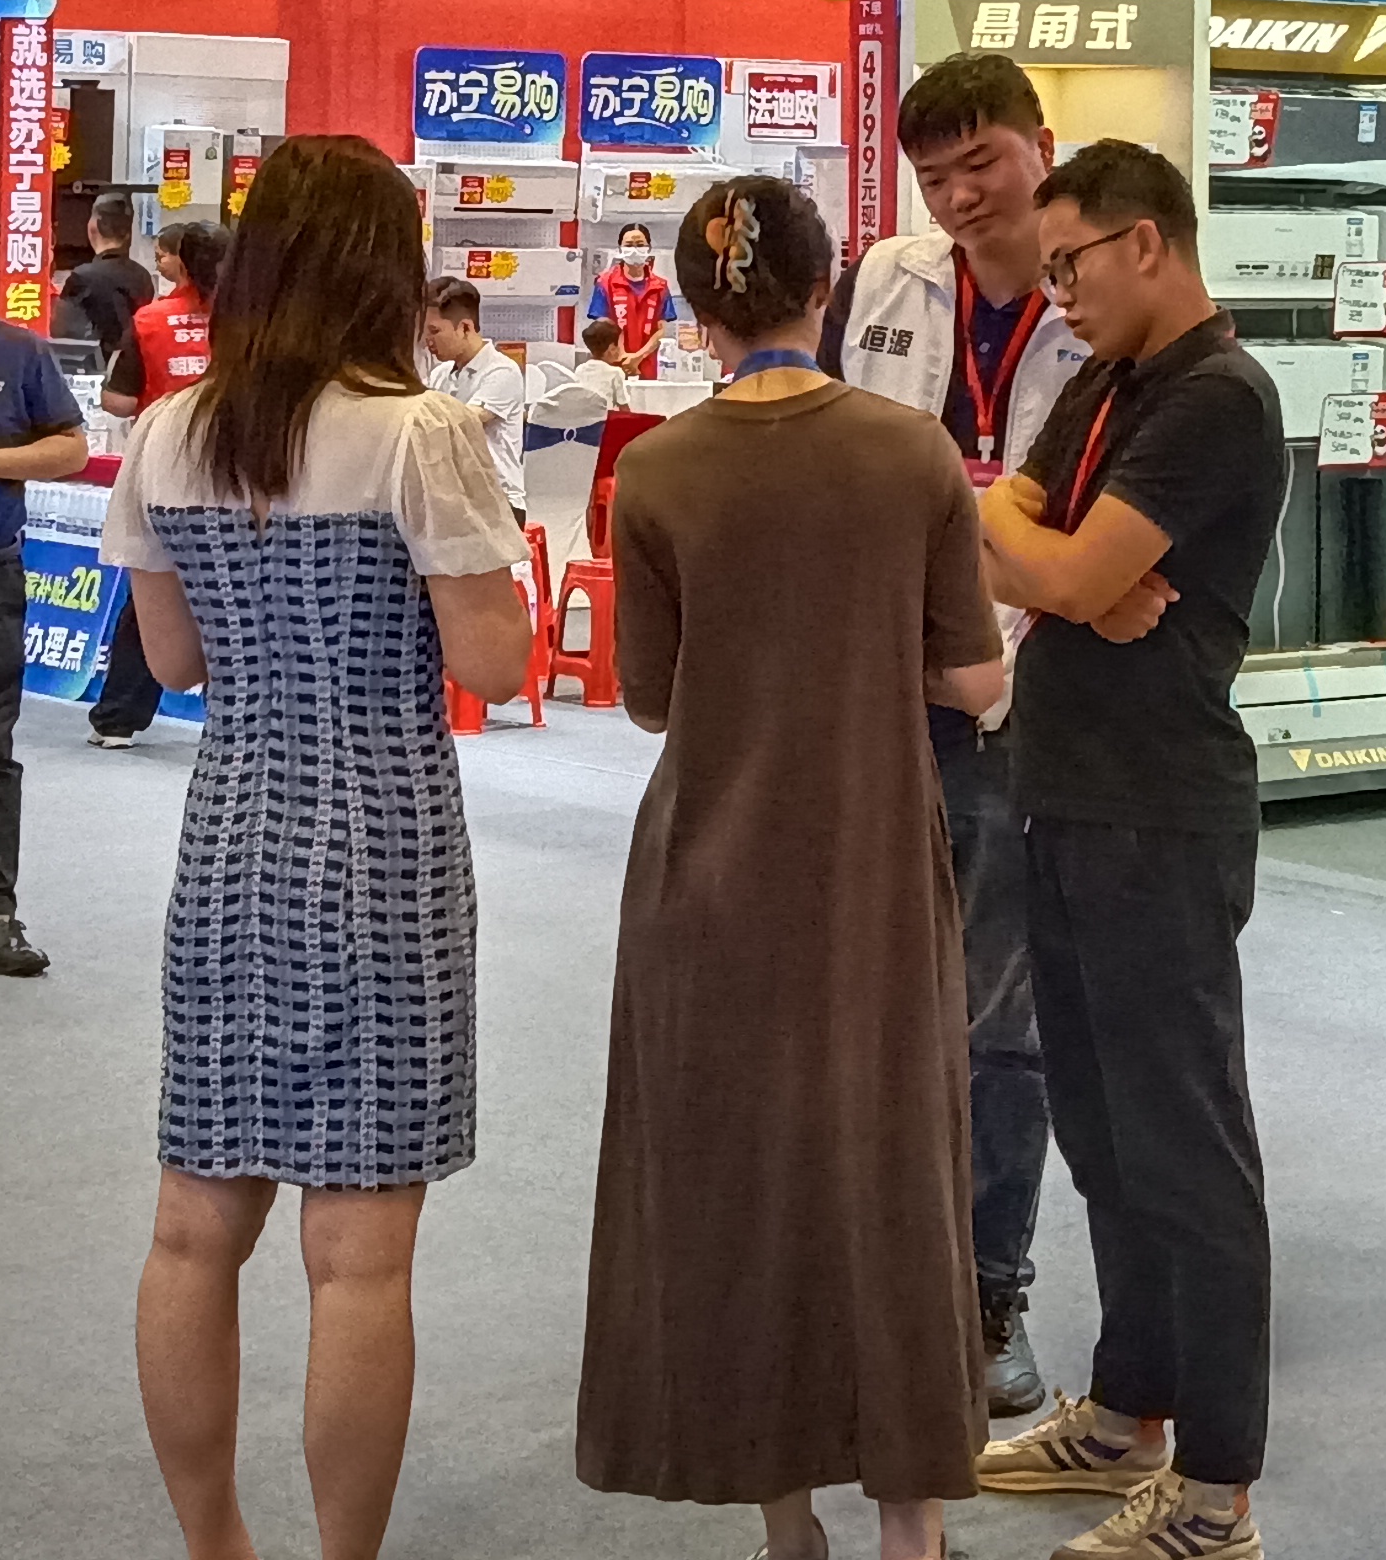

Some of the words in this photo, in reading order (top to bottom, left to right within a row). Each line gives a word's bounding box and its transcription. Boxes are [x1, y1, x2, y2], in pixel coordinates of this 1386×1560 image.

[422, 69, 559, 121] 苏宁易购
[588, 72, 716, 126] 苏宁易购
[749, 87, 817, 126] 法迪欧
[858, 324, 914, 357] 恒源
